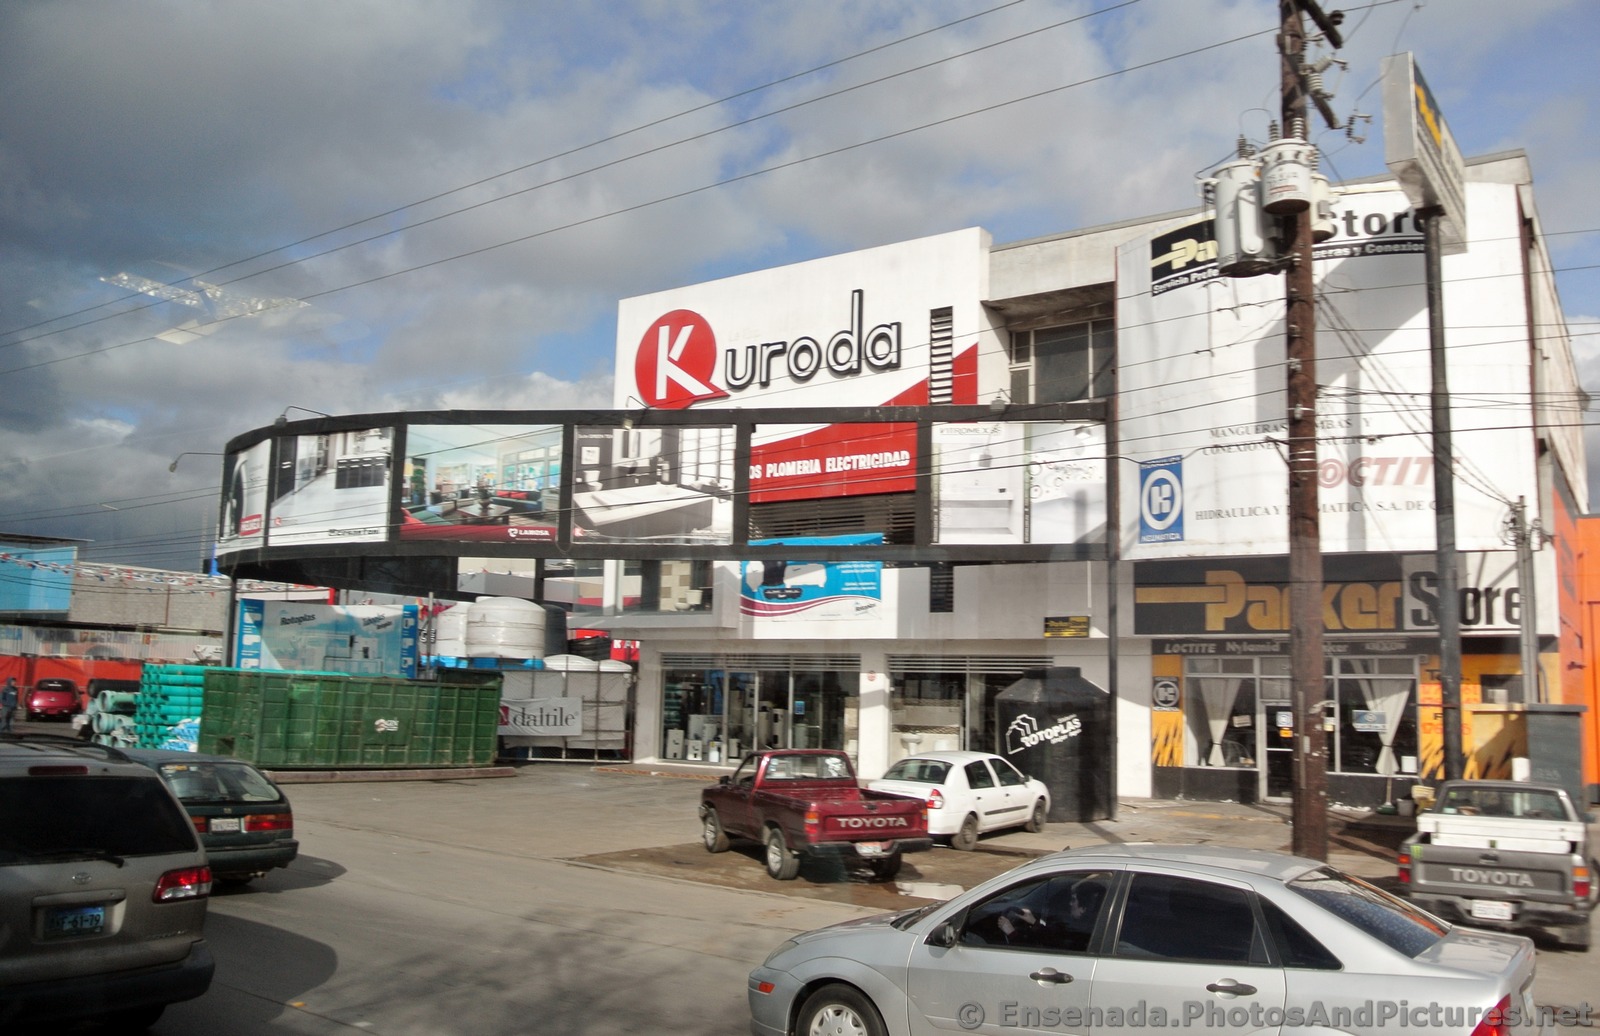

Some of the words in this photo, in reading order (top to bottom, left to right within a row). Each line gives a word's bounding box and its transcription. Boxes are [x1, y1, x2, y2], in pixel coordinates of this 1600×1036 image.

[1330, 210, 1425, 237] tor
[655, 289, 902, 400] Kuroda
[766, 458, 821, 478] PLOMERIA
[825, 450, 911, 473] ELECTRICIDAD
[1316, 456, 1461, 489] OCTIT
[1194, 505, 1271, 521] HIDRAULICA
[1376, 501, 1402, 512] S.A.
[1406, 500, 1425, 512] DE
[1409, 571, 1520, 626] Sore
[1164, 643, 1217, 654] LOCTITE
[837, 816, 908, 829] TOYOTA
[1448, 868, 1534, 888] TOYOTA
